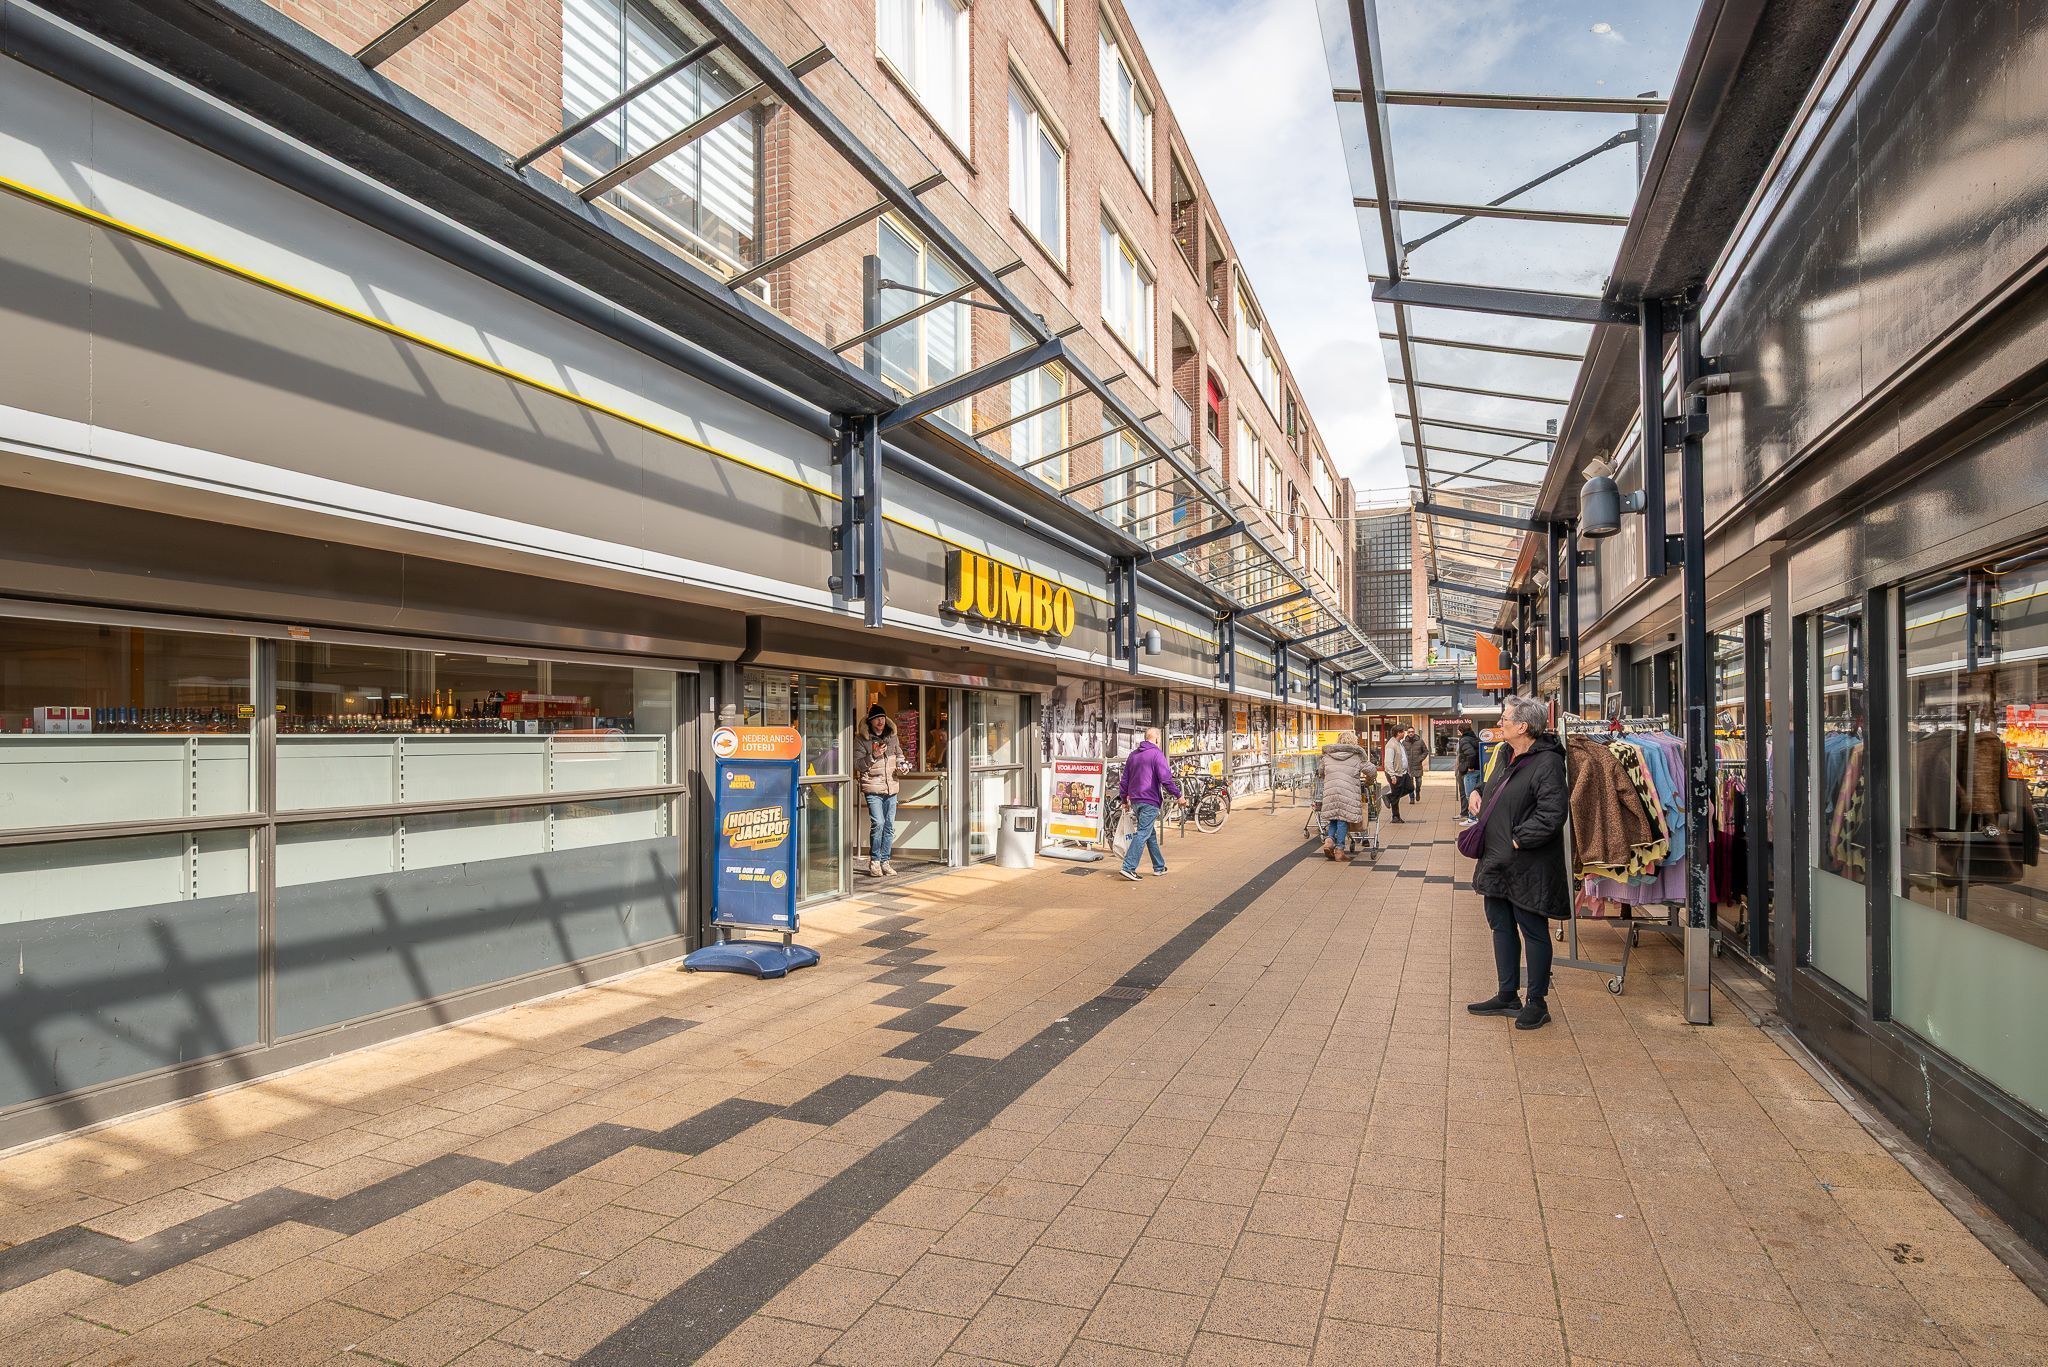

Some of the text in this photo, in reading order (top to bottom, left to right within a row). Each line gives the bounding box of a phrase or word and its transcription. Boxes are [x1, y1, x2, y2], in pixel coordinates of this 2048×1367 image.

[952, 549, 1075, 638] JUMBO
[742, 734, 794, 744] NEDERLANDSE
[742, 743, 775, 752] LOTERIJ
[728, 807, 781, 828] HOOGSTE
[735, 820, 789, 841] JACKPOT
